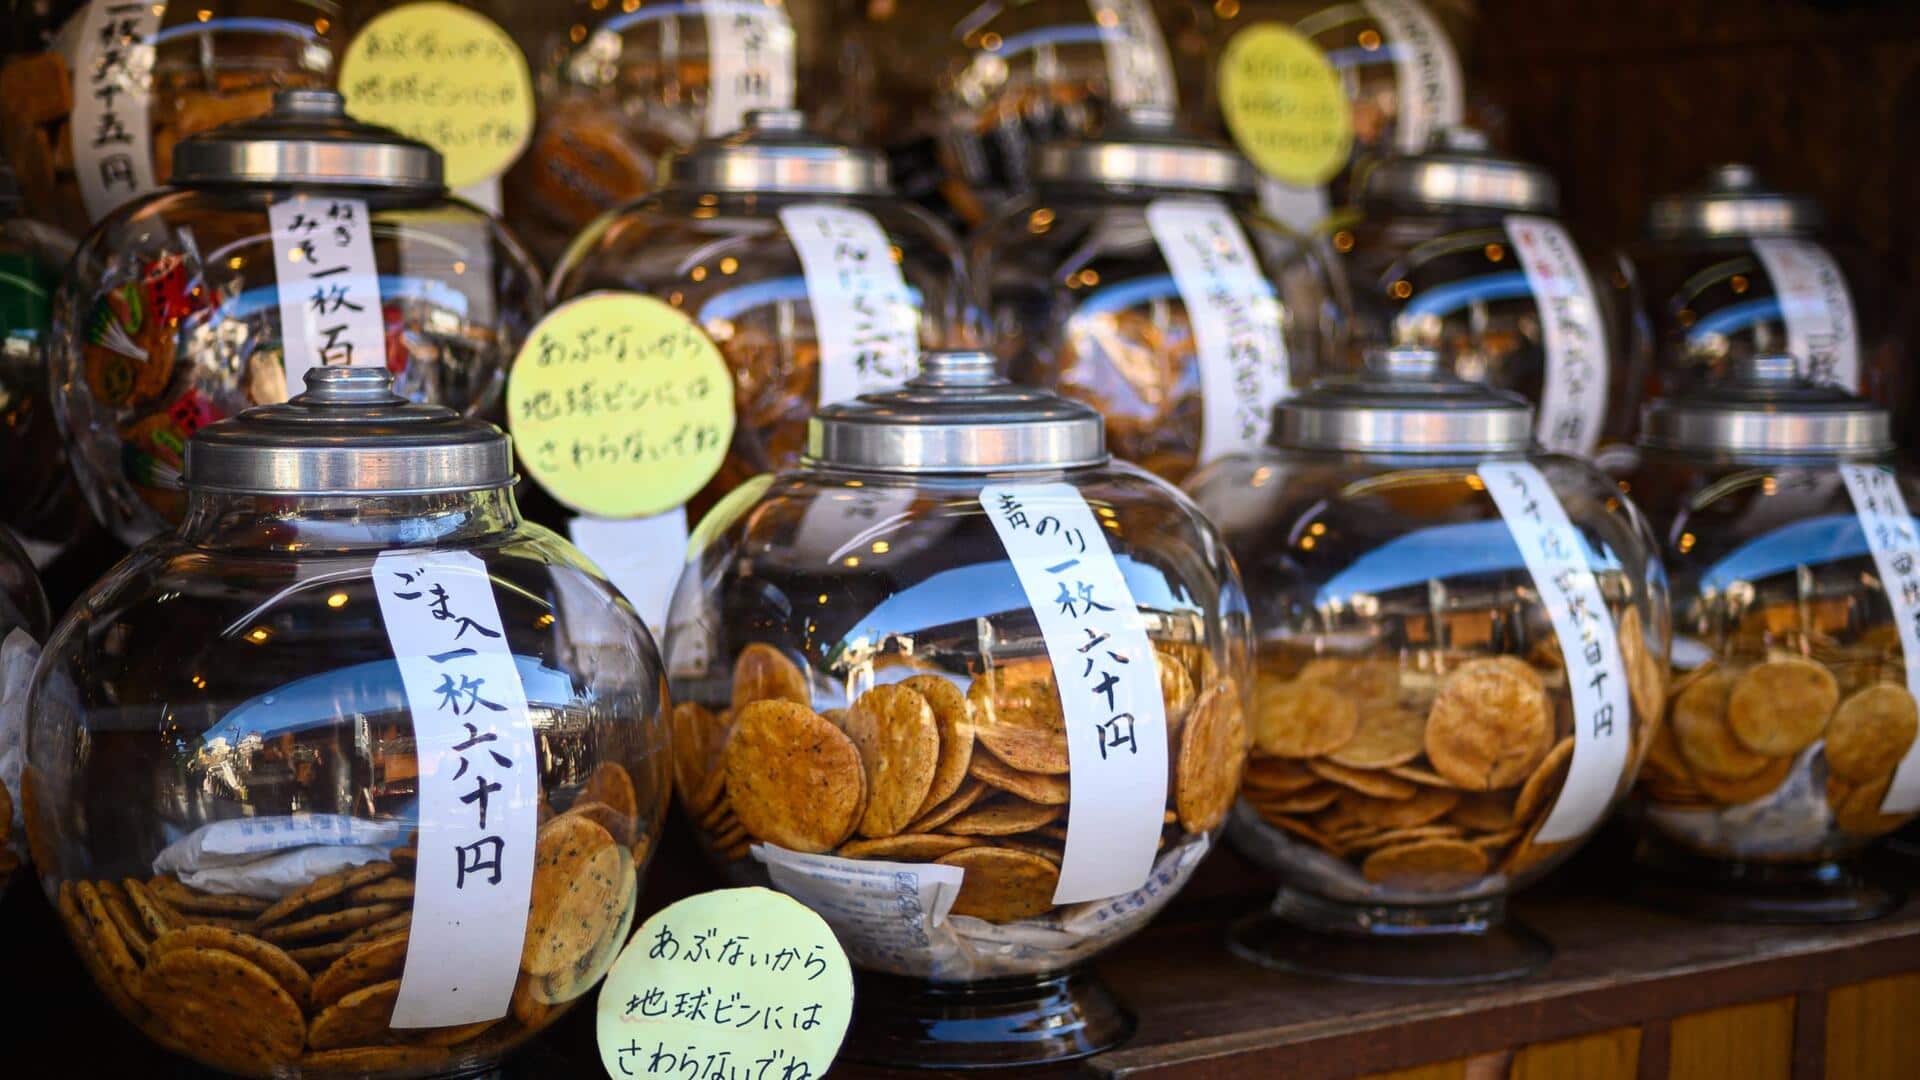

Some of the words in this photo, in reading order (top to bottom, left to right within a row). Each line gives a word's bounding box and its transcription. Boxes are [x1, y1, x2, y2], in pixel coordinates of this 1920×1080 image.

[537, 325, 702, 367] あぶないから
[522, 376, 710, 420] 地球ビンには
[538, 426, 720, 473] さわらないでね
[999, 491, 1138, 761] 青のり一枚六十円
[392, 567, 508, 890] ごま入一枚六十円
[649, 924, 827, 981] あぶないから
[625, 986, 824, 1031] 地球ビンには
[617, 1039, 813, 1080] さわらないでね
